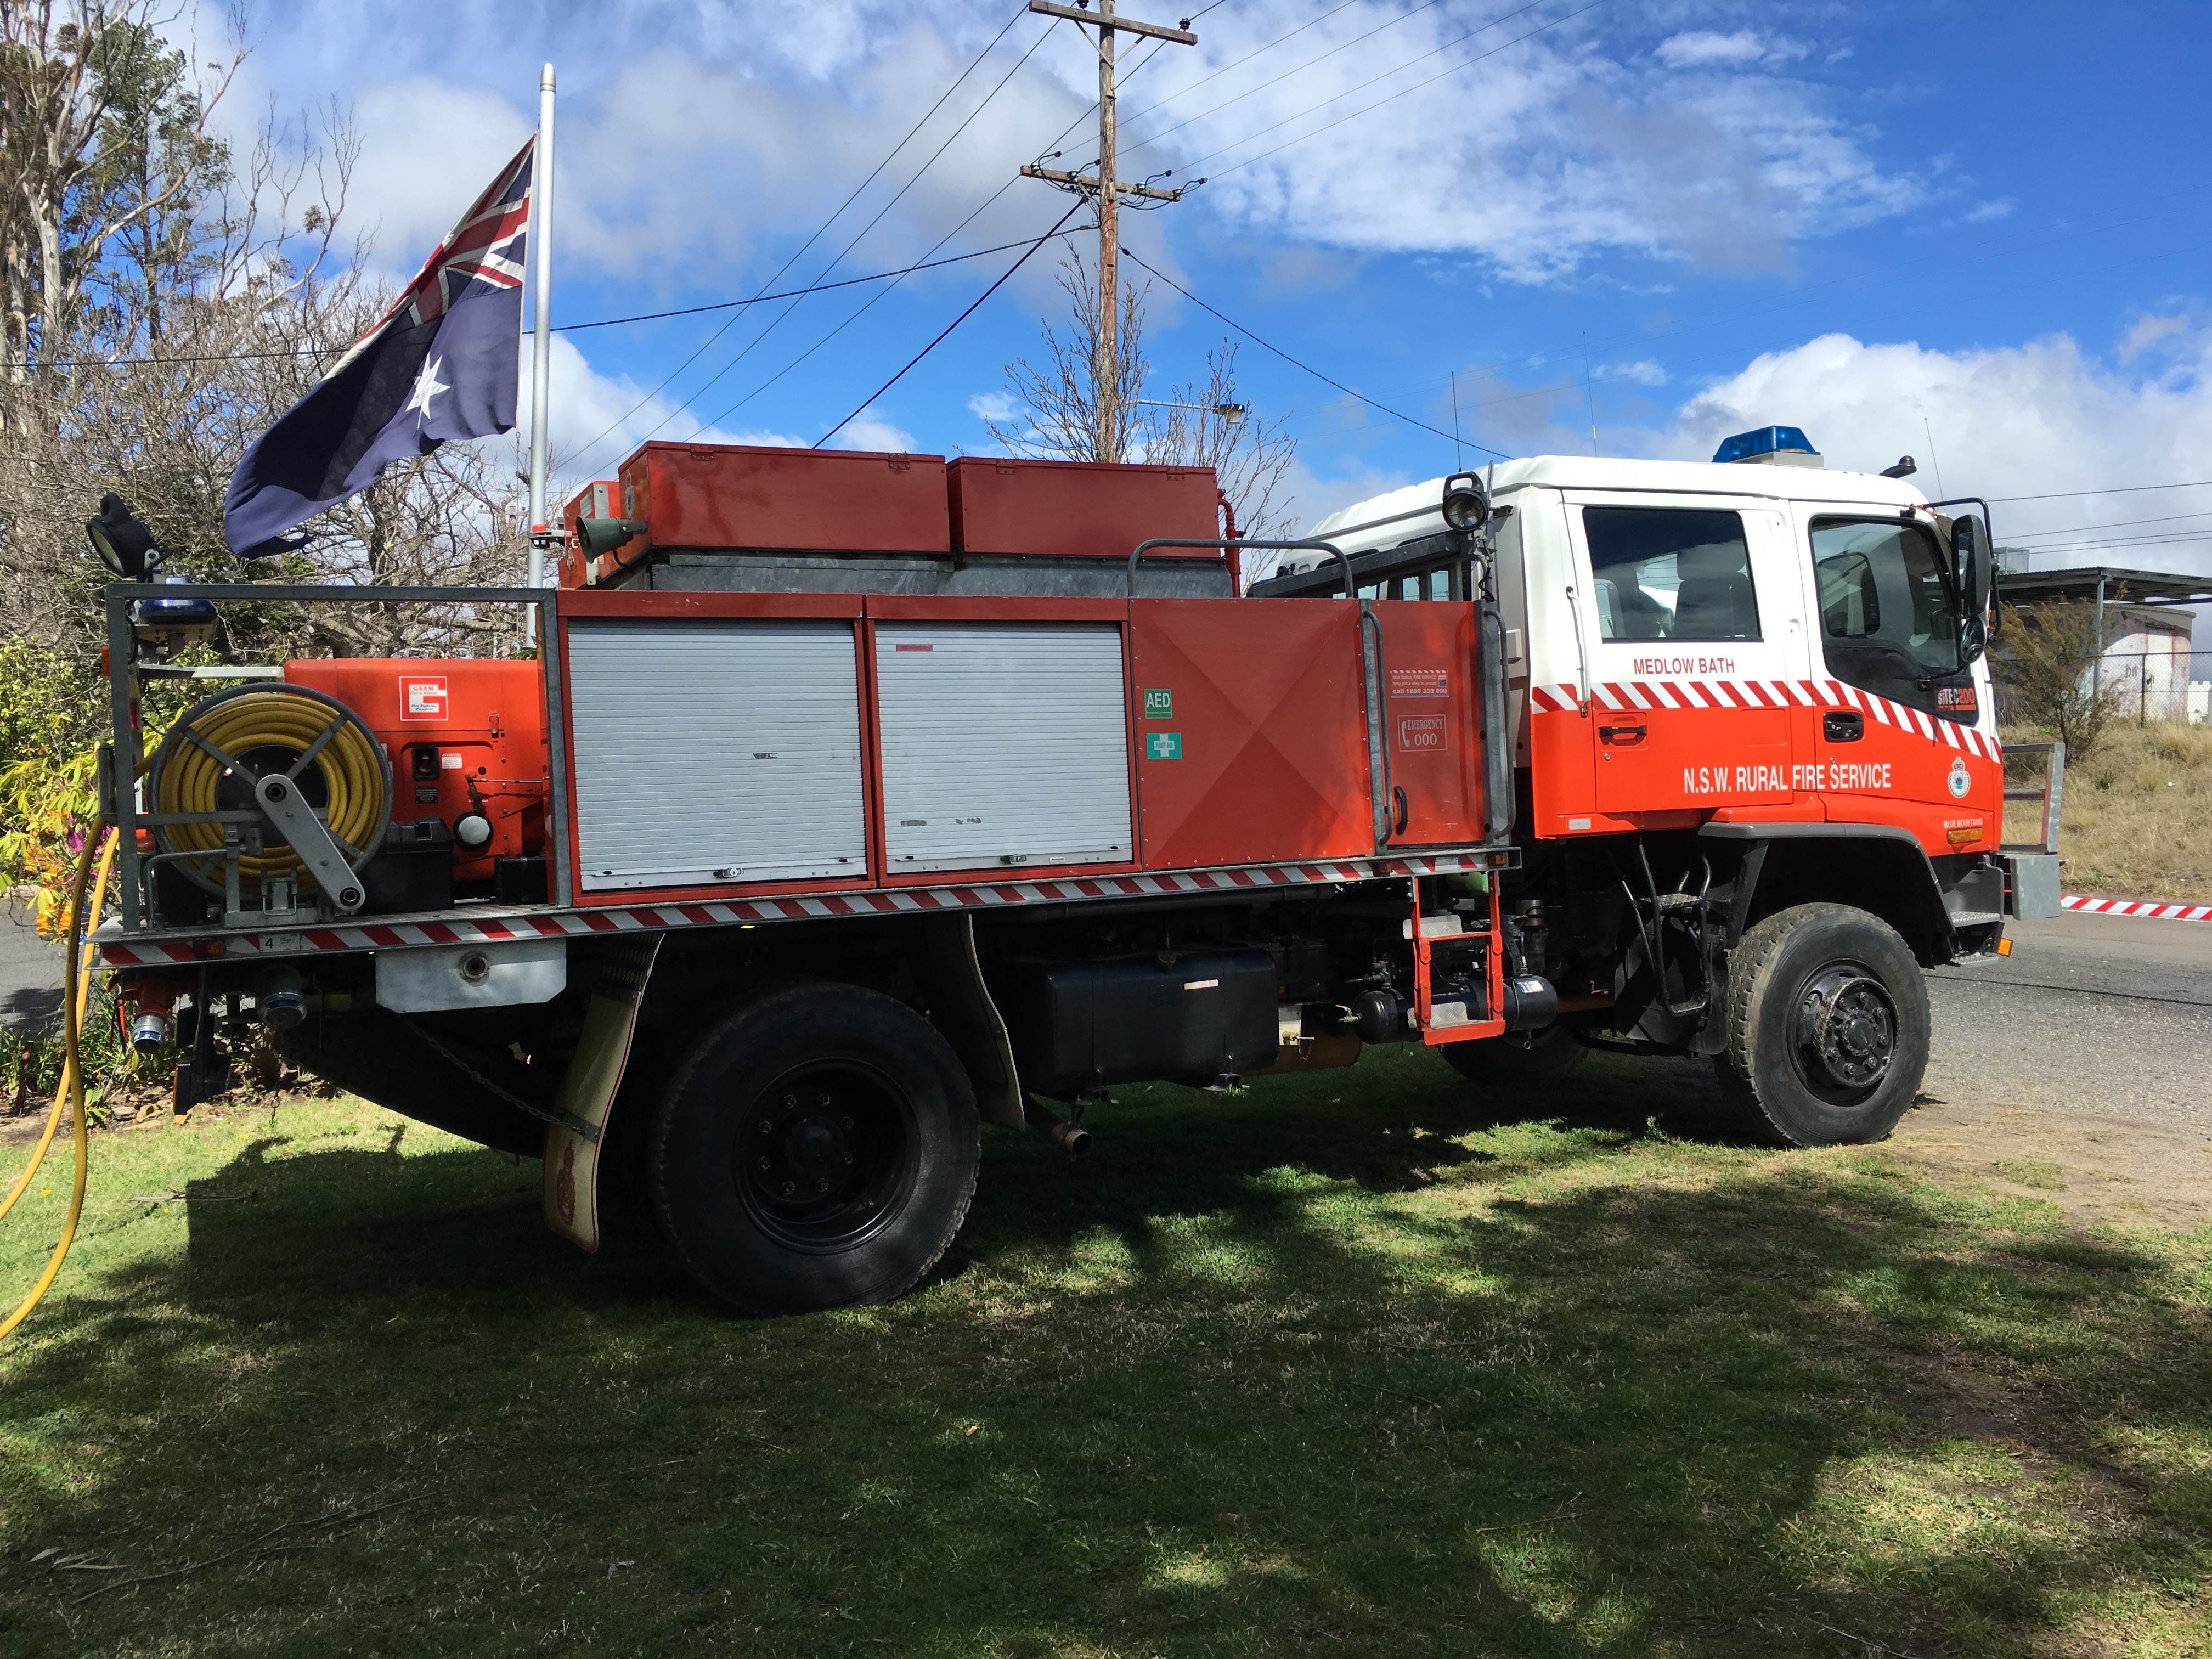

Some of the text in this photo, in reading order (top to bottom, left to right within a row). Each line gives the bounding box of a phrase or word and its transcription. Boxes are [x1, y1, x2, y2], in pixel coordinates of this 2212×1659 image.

[1633, 657, 1735, 675] MEDLOW BATH
[1147, 693, 1170, 708] AED
[1407, 719, 1443, 730] EMERGENCY
[1414, 733, 1437, 746] 000
[1684, 764, 1892, 793] N.S.W. RURAL FIRE SERVICE
[1943, 817, 1983, 829] BLUE MOUNTAINS
[265, 938, 274, 949] 4
